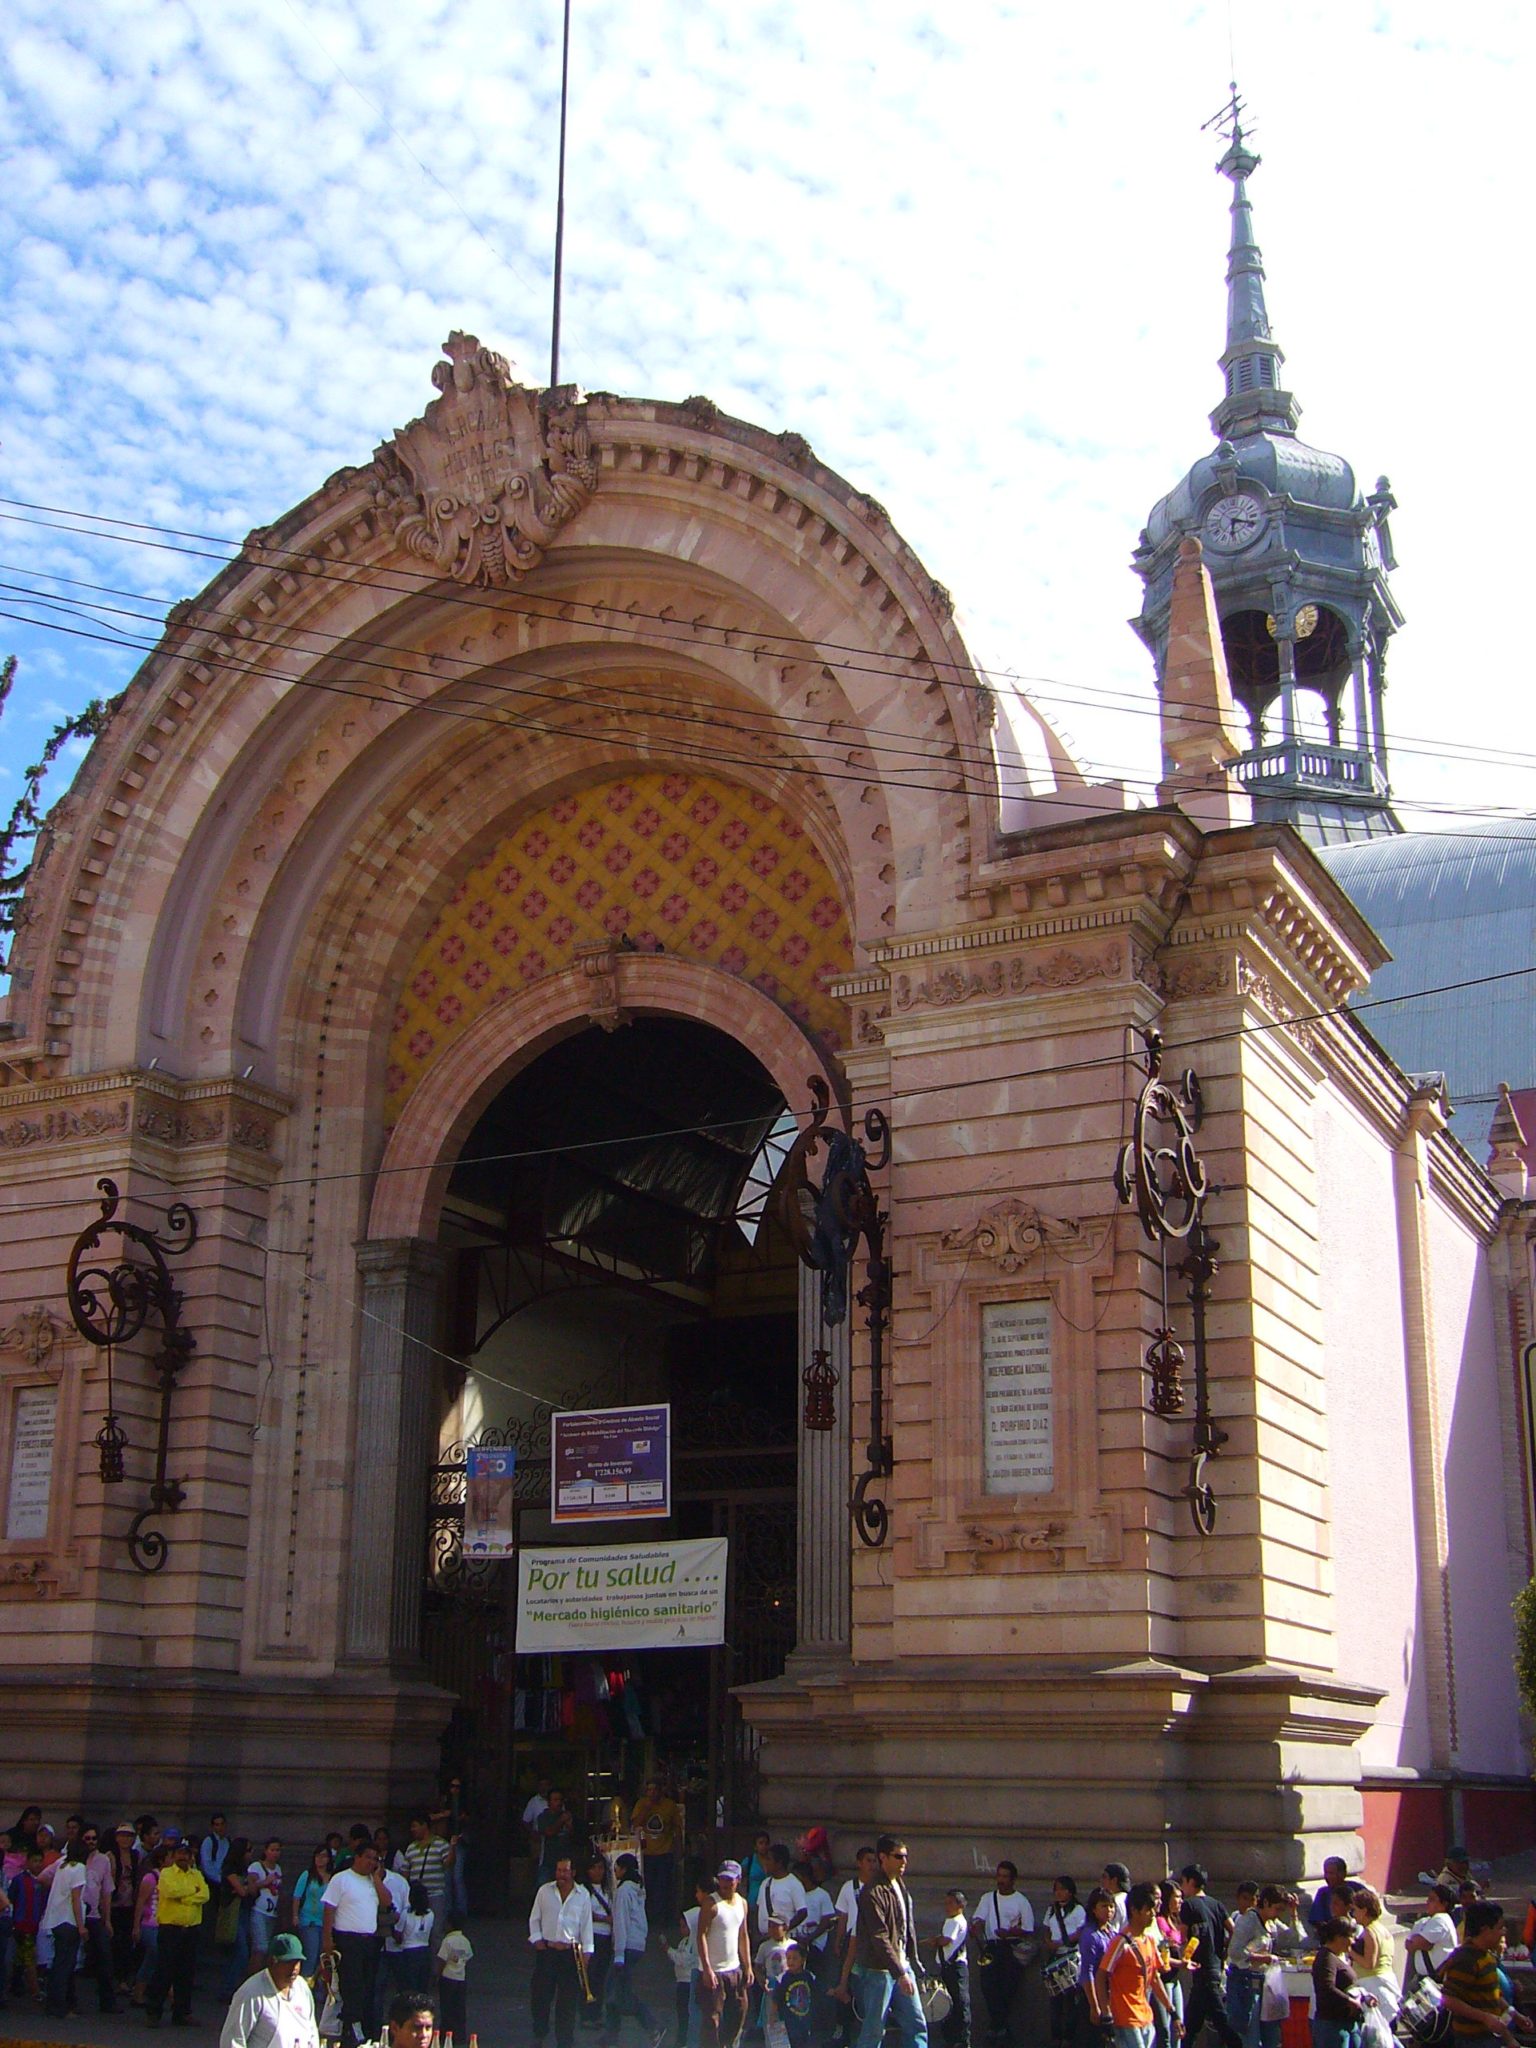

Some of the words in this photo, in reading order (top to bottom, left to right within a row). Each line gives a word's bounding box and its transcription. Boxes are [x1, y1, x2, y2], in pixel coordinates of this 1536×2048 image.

[531, 1556, 566, 1566] Programa
[567, 1556, 577, 1564] de
[578, 1554, 628, 1563] Comunidades
[629, 1551, 670, 1561] Saludables
[527, 1568, 570, 1591] Por
[576, 1566, 598, 1589] tu
[606, 1560, 676, 1587] salud
[525, 1597, 559, 1605] Locatarios
[565, 1595, 603, 1604] autoridades
[606, 1593, 643, 1602] trabajamos
[644, 1591, 667, 1600] juntos
[678, 1589, 699, 1598] busca
[700, 1588, 708, 1596] de
[590, 1605, 649, 1621] higiénico
